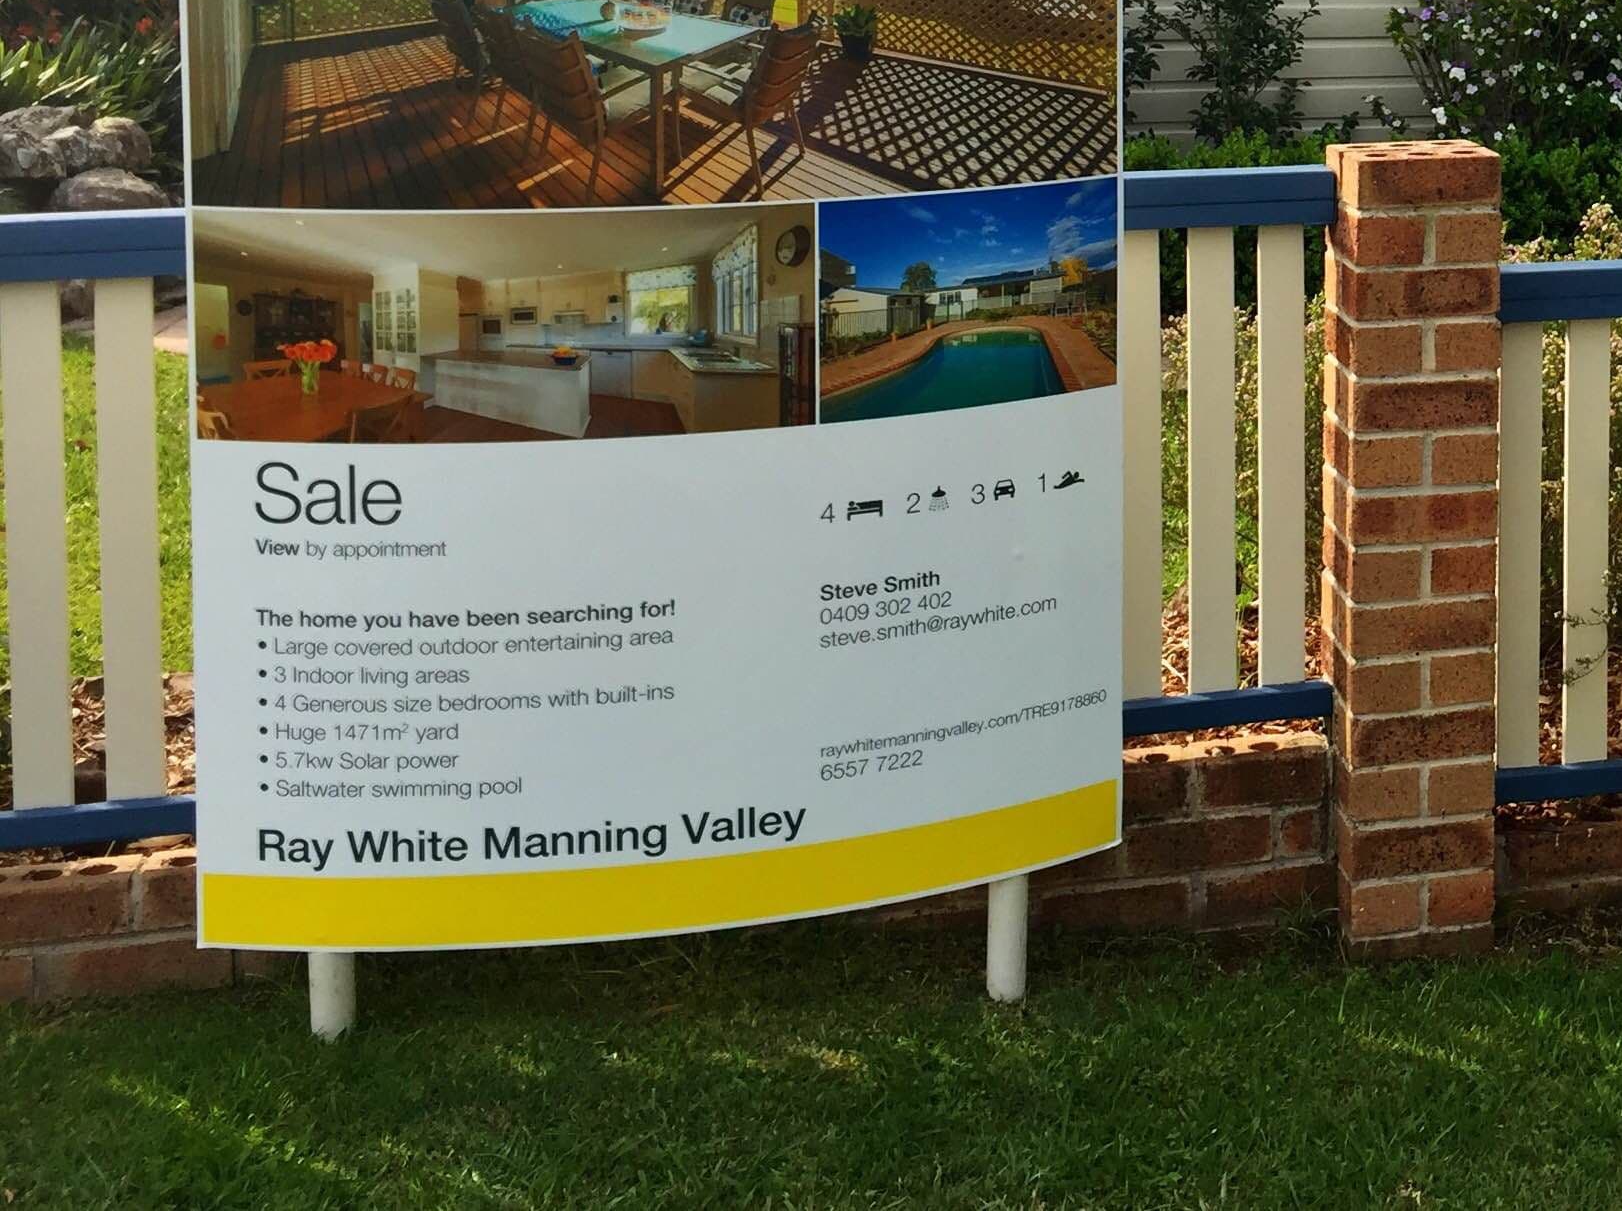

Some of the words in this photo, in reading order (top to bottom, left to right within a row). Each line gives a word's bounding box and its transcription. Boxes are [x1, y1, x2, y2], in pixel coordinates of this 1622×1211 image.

[255, 461, 402, 526] Sale
[820, 503, 835, 523] 4
[906, 492, 921, 514] 2
[971, 484, 986, 505] 3
[1038, 473, 1046, 492] 1
[255, 539, 300, 556] View
[306, 541, 327, 560] by
[333, 541, 447, 560] appointment
[820, 584, 878, 601] Steve
[884, 571, 940, 593] Smith
[256, 609, 293, 627] The
[300, 610, 357, 628] home
[363, 615, 402, 632] you
[409, 611, 460, 628] have
[467, 610, 520, 626] been
[527, 604, 633, 623] searching
[639, 599, 675, 618] for!
[820, 603, 869, 625] 0409
[875, 598, 911, 619] 302
[918, 591, 952, 611] 402
[820, 596, 1057, 648] steve.smith@raywhite.com
[274, 638, 328, 659] Large
[334, 639, 412, 655] covered
[419, 637, 498, 655] outdoor
[505, 631, 623, 651] entertaining
[629, 629, 674, 646] area
[274, 666, 287, 683] 3
[293, 666, 354, 684] Indoor
[360, 667, 408, 688] living
[415, 669, 470, 684] areas
[275, 695, 286, 711] 4
[293, 694, 387, 713] Generous
[393, 696, 432, 712] size
[439, 694, 541, 712] bedrooms
[548, 689, 589, 707] with
[596, 685, 675, 704] built-ins
[275, 723, 326, 744] Huge
[415, 723, 459, 744] yard
[275, 751, 333, 769] 5.7kw
[340, 752, 390, 769] Solar
[397, 754, 459, 772] power
[820, 758, 868, 781] 6557
[876, 749, 923, 772] 7222
[276, 779, 365, 797] Saltwater
[371, 780, 472, 800] swimming
[479, 777, 522, 798] pool
[258, 829, 334, 872] Ray
[346, 829, 468, 863] White
[484, 821, 668, 859] Manning
[681, 807, 807, 845] Valley
